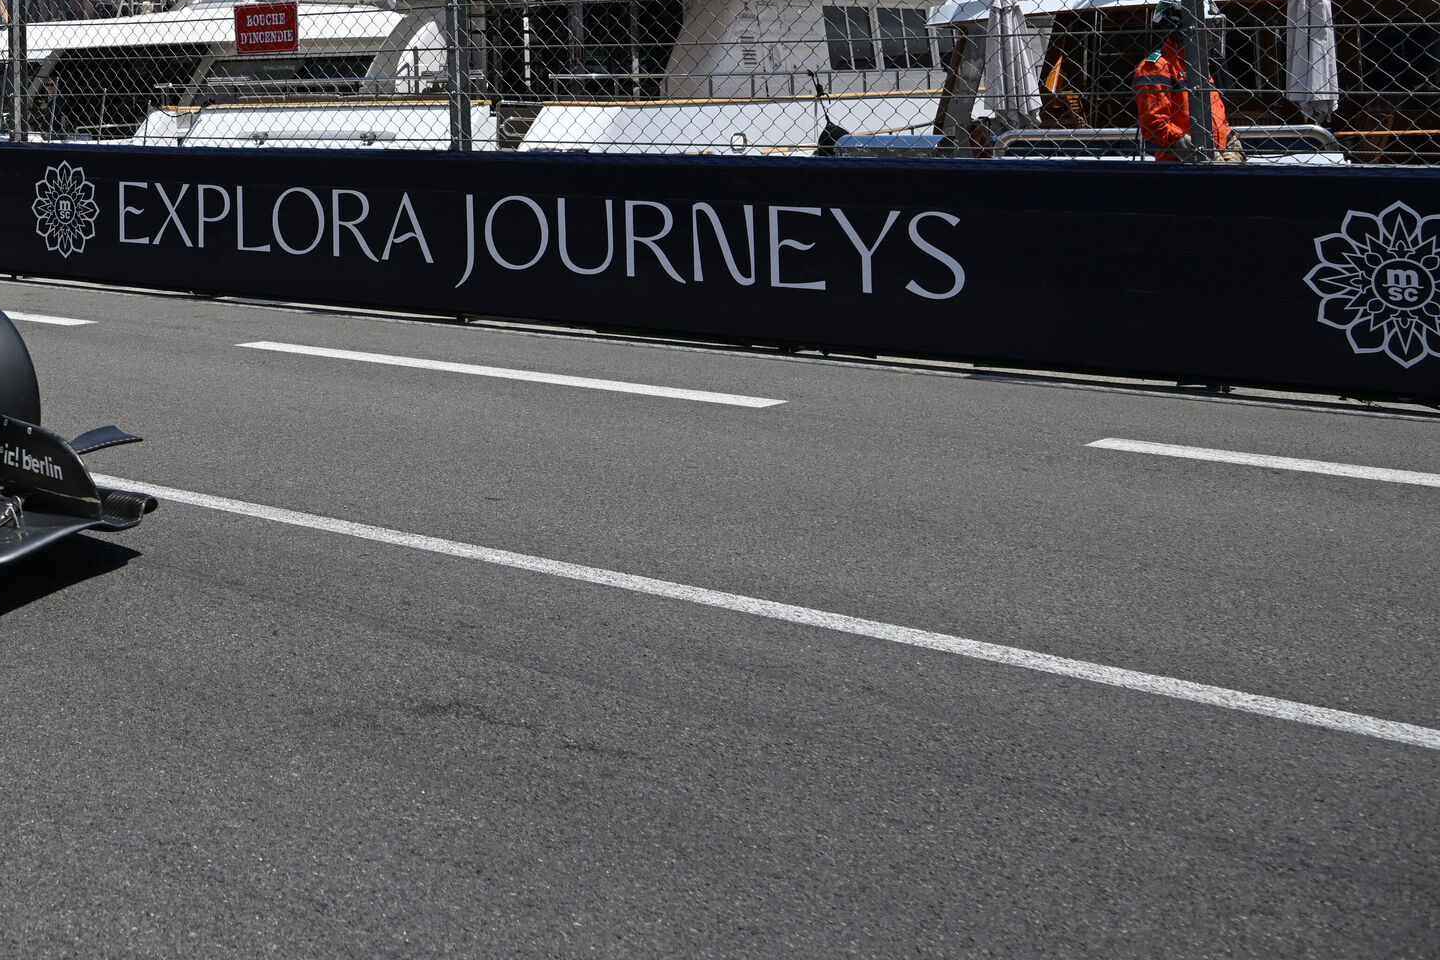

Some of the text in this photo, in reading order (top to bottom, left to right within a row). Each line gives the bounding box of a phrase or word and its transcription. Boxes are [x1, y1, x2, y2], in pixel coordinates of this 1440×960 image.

[246, 13, 286, 27] BOUCHE
[240, 30, 294, 45] D'INCENDIE
[118, 180, 967, 300] EXPLORA JOURNEYS
[3, 443, 64, 480] ic! berlin
